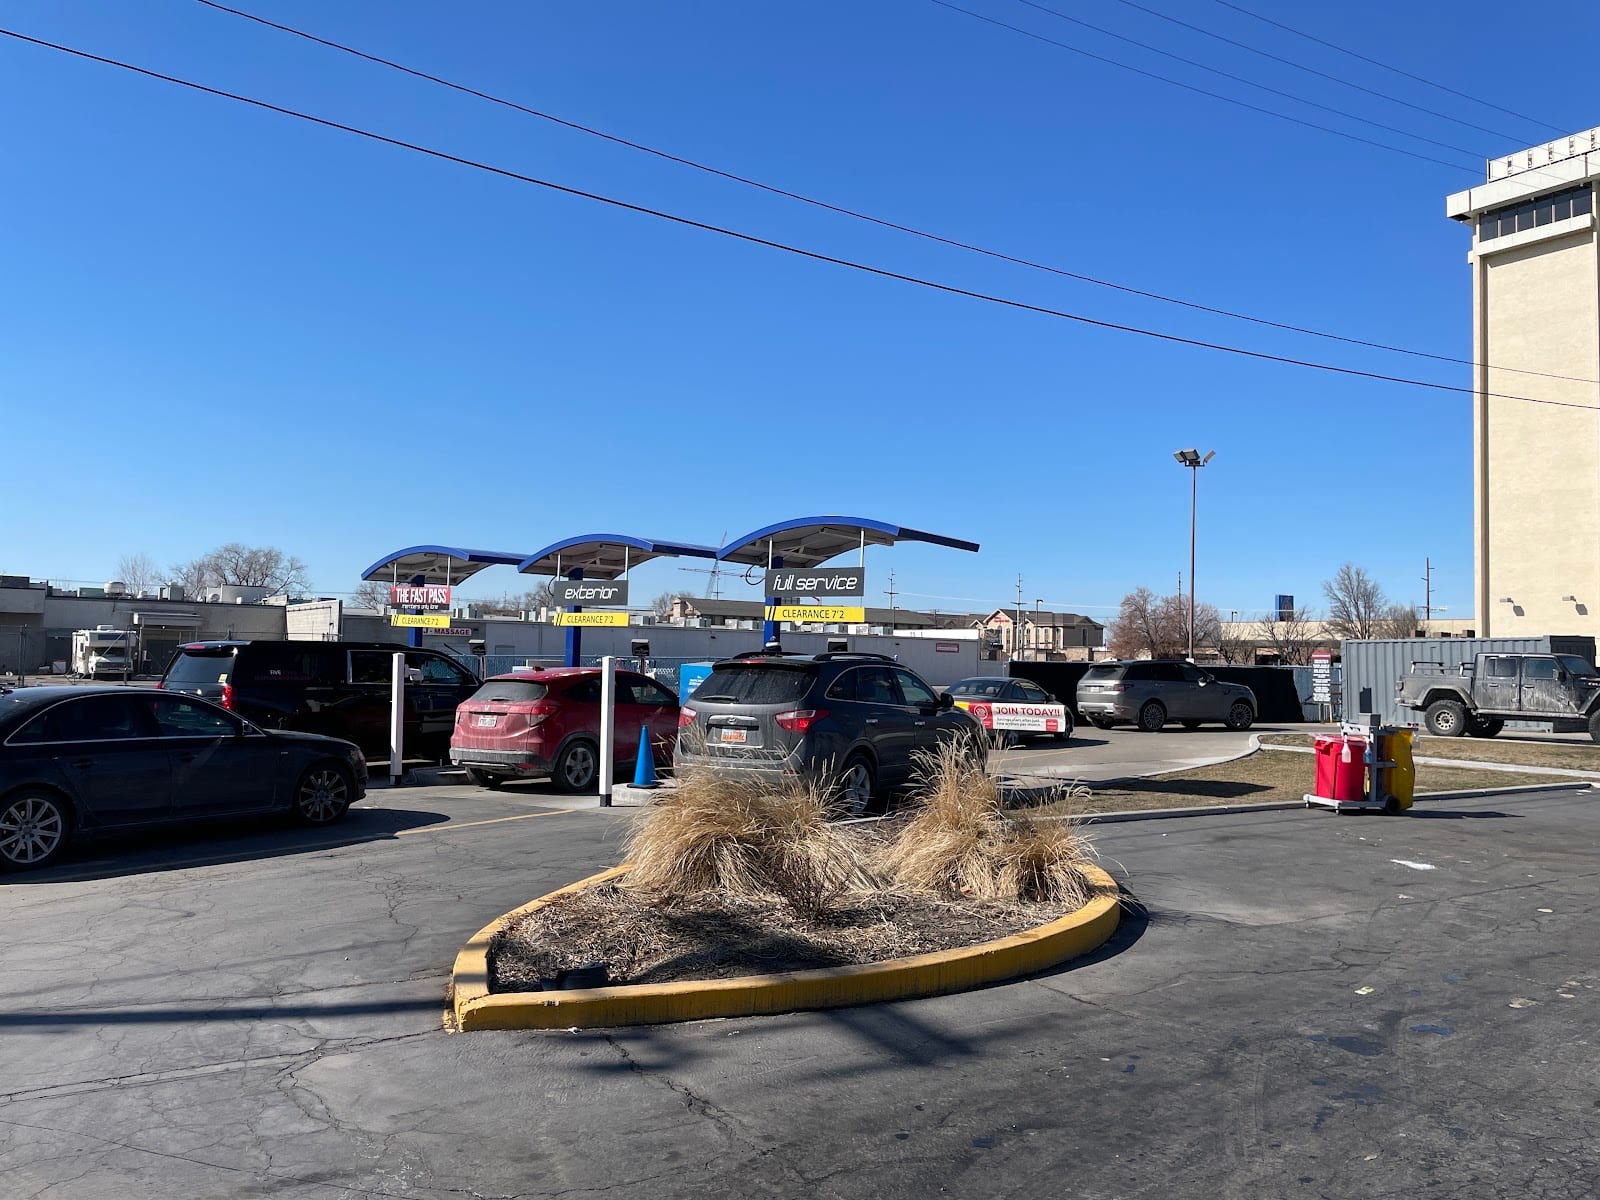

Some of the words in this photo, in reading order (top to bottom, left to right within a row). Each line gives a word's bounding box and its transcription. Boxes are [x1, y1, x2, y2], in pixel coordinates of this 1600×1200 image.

[773, 574, 794, 590] full
[795, 575, 858, 590] service
[396, 588, 409, 603] THE
[410, 588, 428, 603] FAST
[428, 588, 447, 604] PASS
[564, 585, 619, 599] exterior
[566, 615, 603, 624] CLEARANCE
[782, 609, 830, 619] CLEARANCE
[401, 617, 431, 625] CLEARANCE
[995, 706, 1019, 715] JOIN
[1020, 707, 1061, 717] TODAY!!
